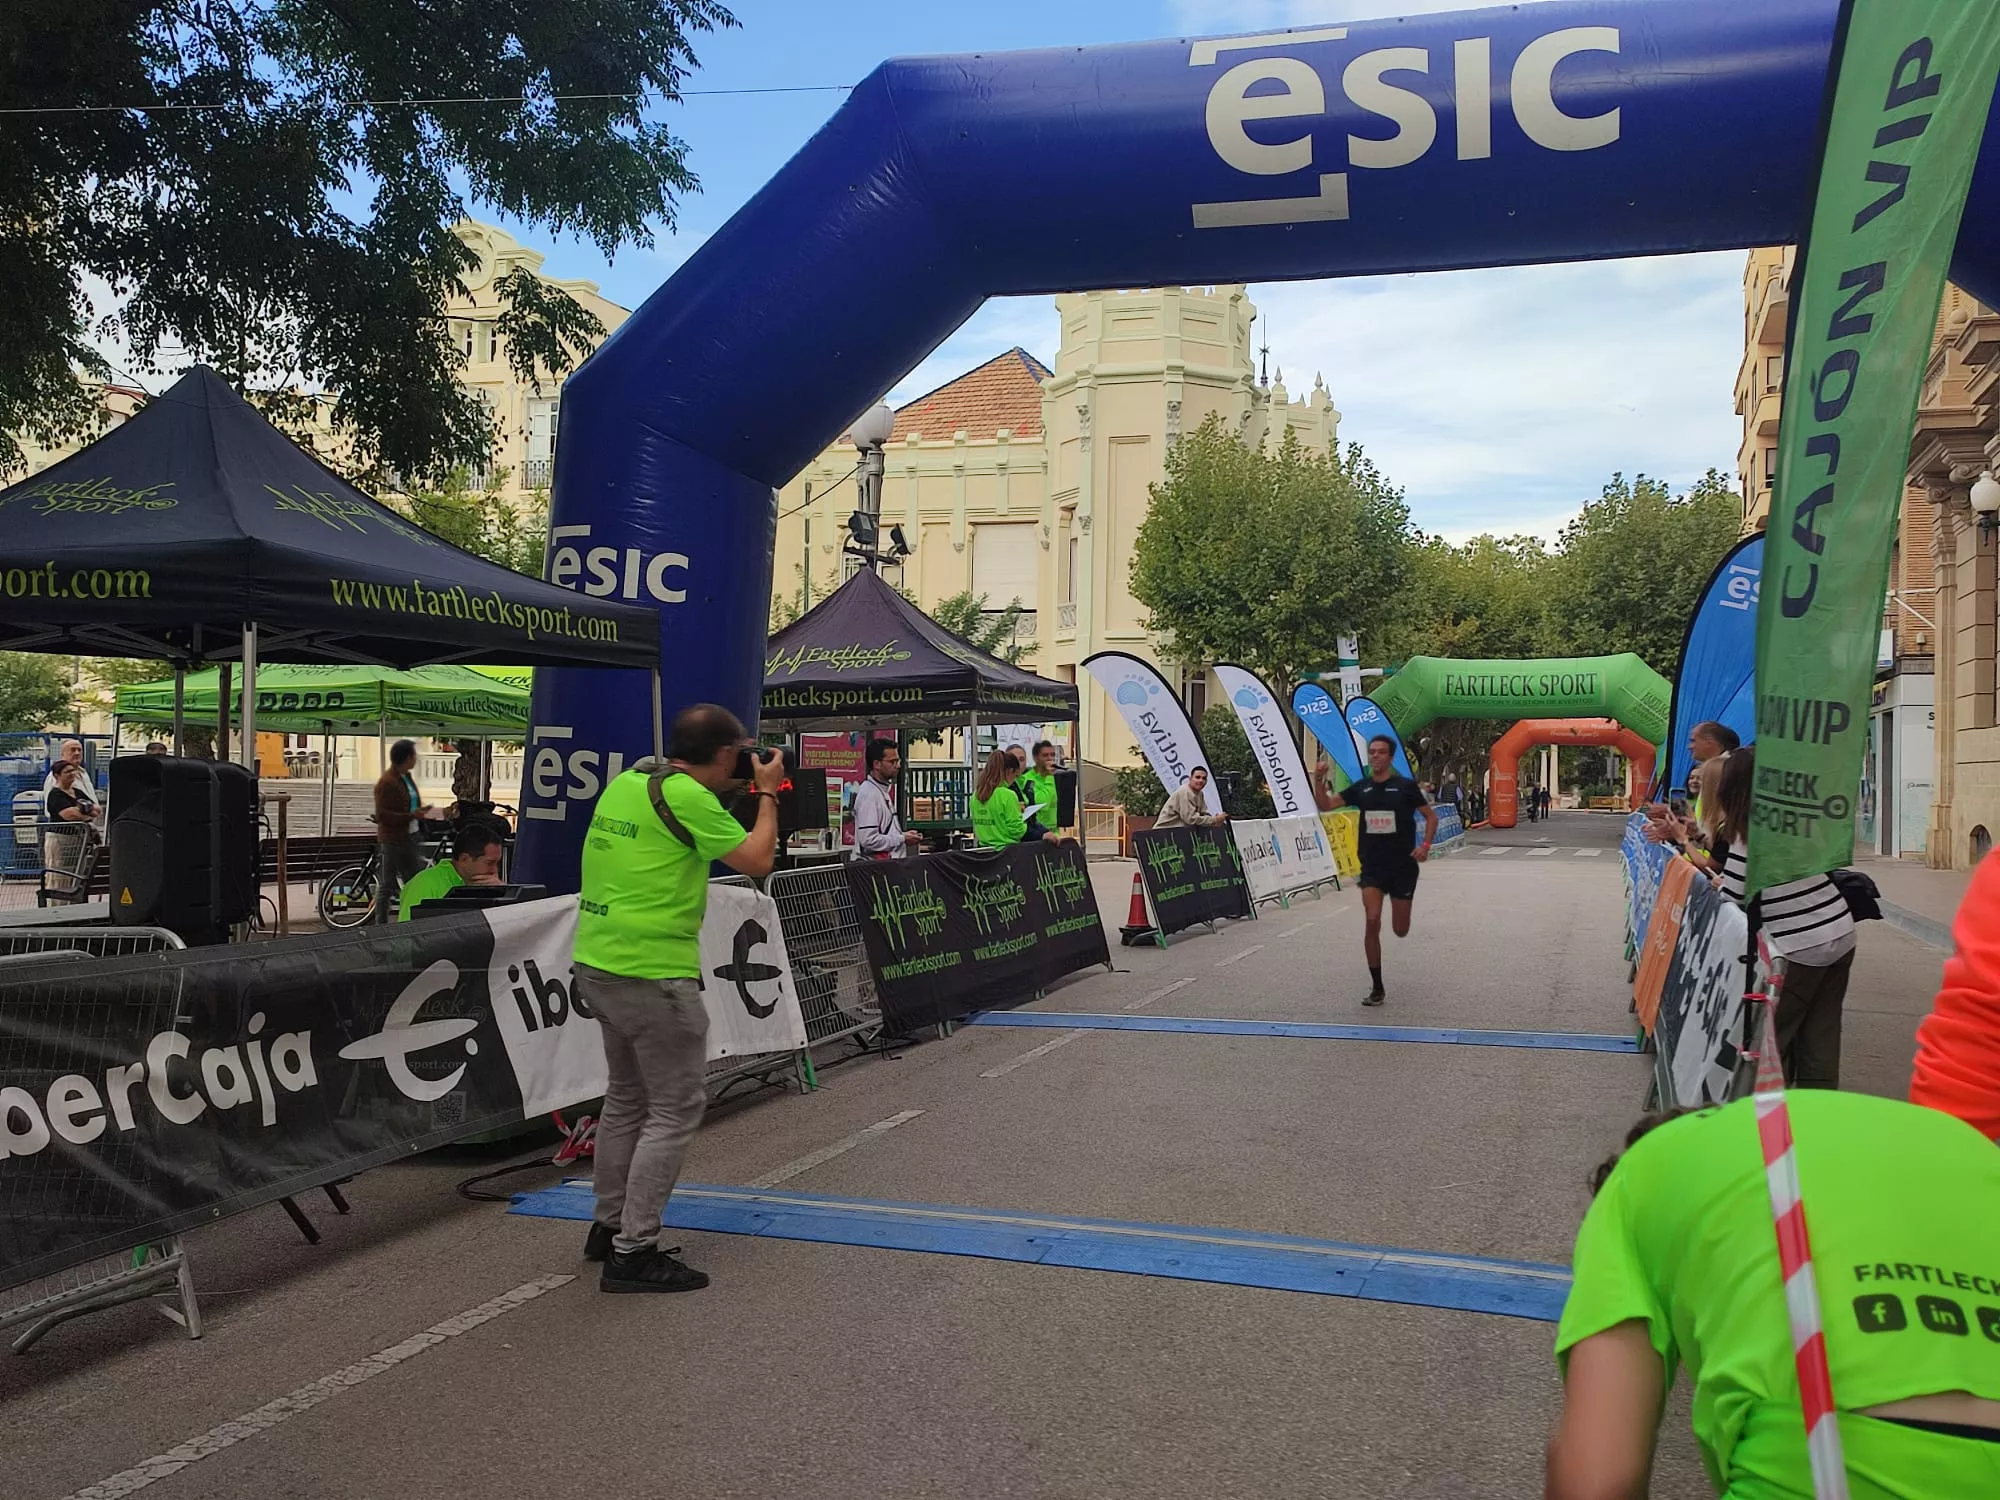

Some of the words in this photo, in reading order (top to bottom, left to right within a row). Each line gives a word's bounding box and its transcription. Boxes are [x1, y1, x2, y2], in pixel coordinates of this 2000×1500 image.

[1782, 261, 1887, 619] CAJÓN
[1852, 36, 1942, 233] VIP
[0, 560, 153, 599] ort.com
[329, 577, 619, 643] www.fartlecksport.com
[1444, 674, 1535, 697] FARTLECK
[1539, 672, 1598, 696] SPORT
[1792, 697, 1851, 745] VIP
